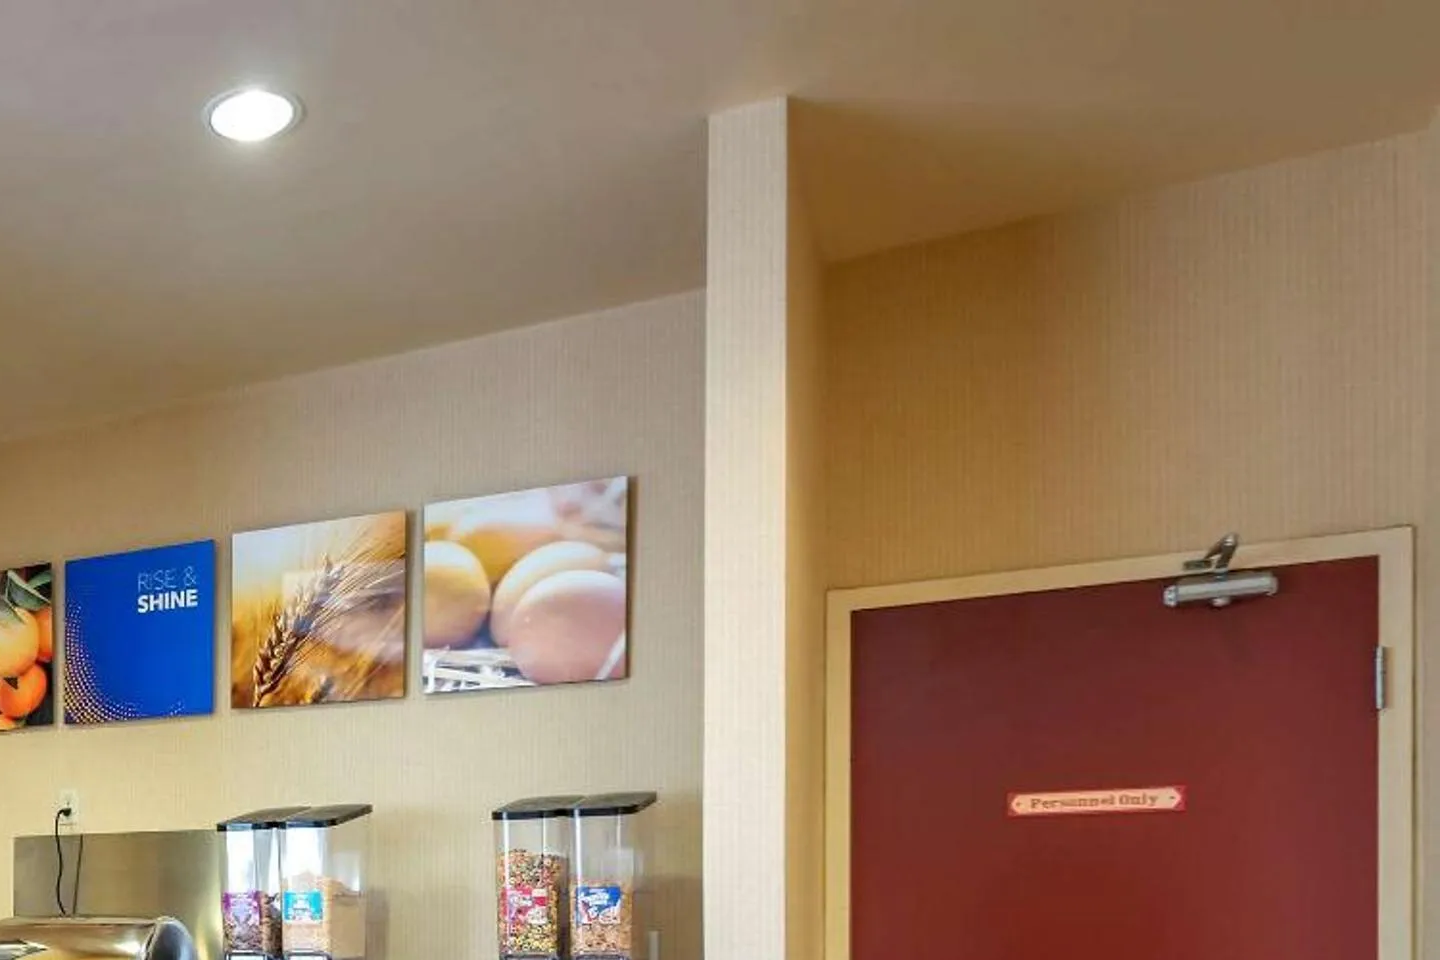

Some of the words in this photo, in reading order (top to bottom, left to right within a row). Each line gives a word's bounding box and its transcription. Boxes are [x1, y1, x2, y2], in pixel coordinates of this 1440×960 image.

[137, 569, 177, 592] RISE
[182, 565, 198, 588] &
[137, 588, 199, 614] SHINE
[1119, 792, 1160, 808] Only
